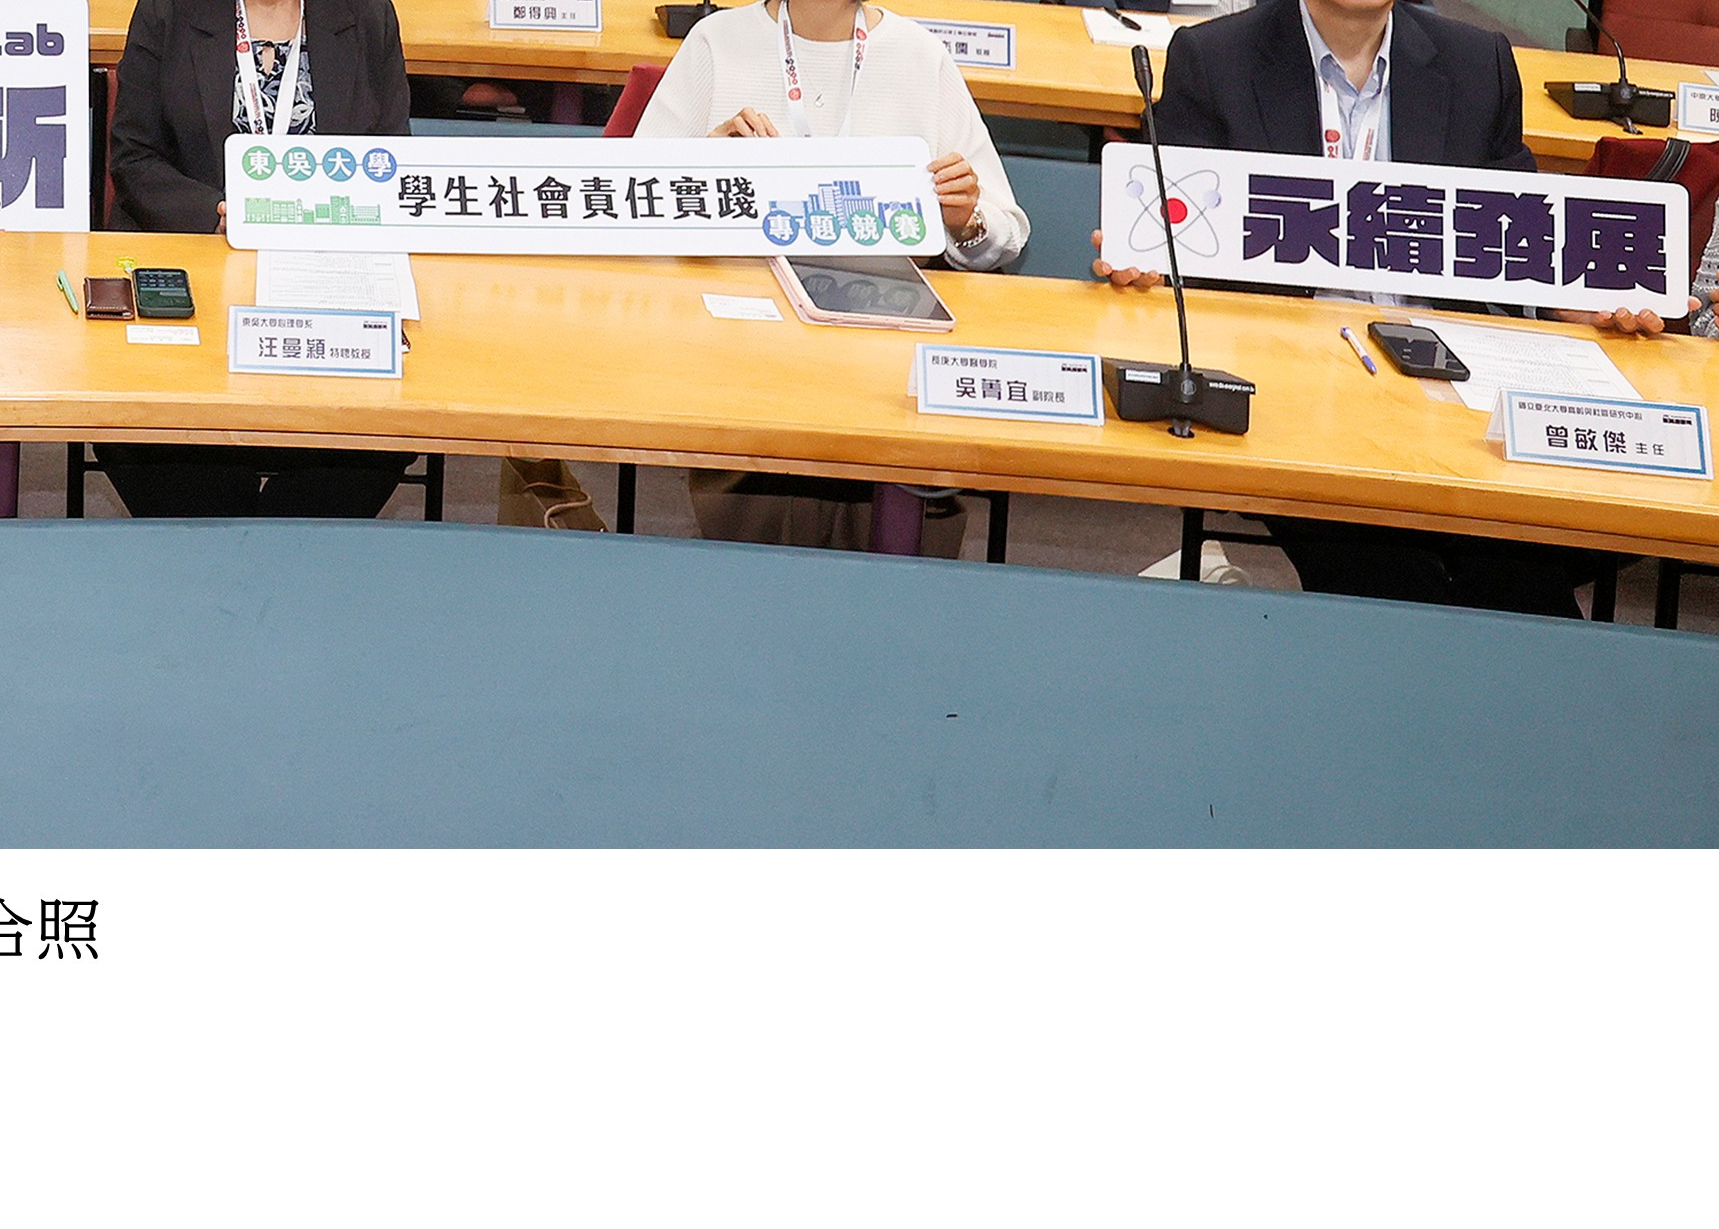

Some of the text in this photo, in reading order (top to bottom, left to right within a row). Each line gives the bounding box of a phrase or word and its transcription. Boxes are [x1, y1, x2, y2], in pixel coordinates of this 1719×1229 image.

[246, 149, 395, 178] 東吳大學
[397, 175, 760, 220] 學生社會責任實踐
[766, 212, 923, 244] 專題競賽
[1243, 174, 1667, 295] 永續發展
[329, 347, 371, 360] 特聘教授
[1032, 390, 1066, 404] 副院長
[1545, 424, 1665, 456] 曾敏傑 主任
